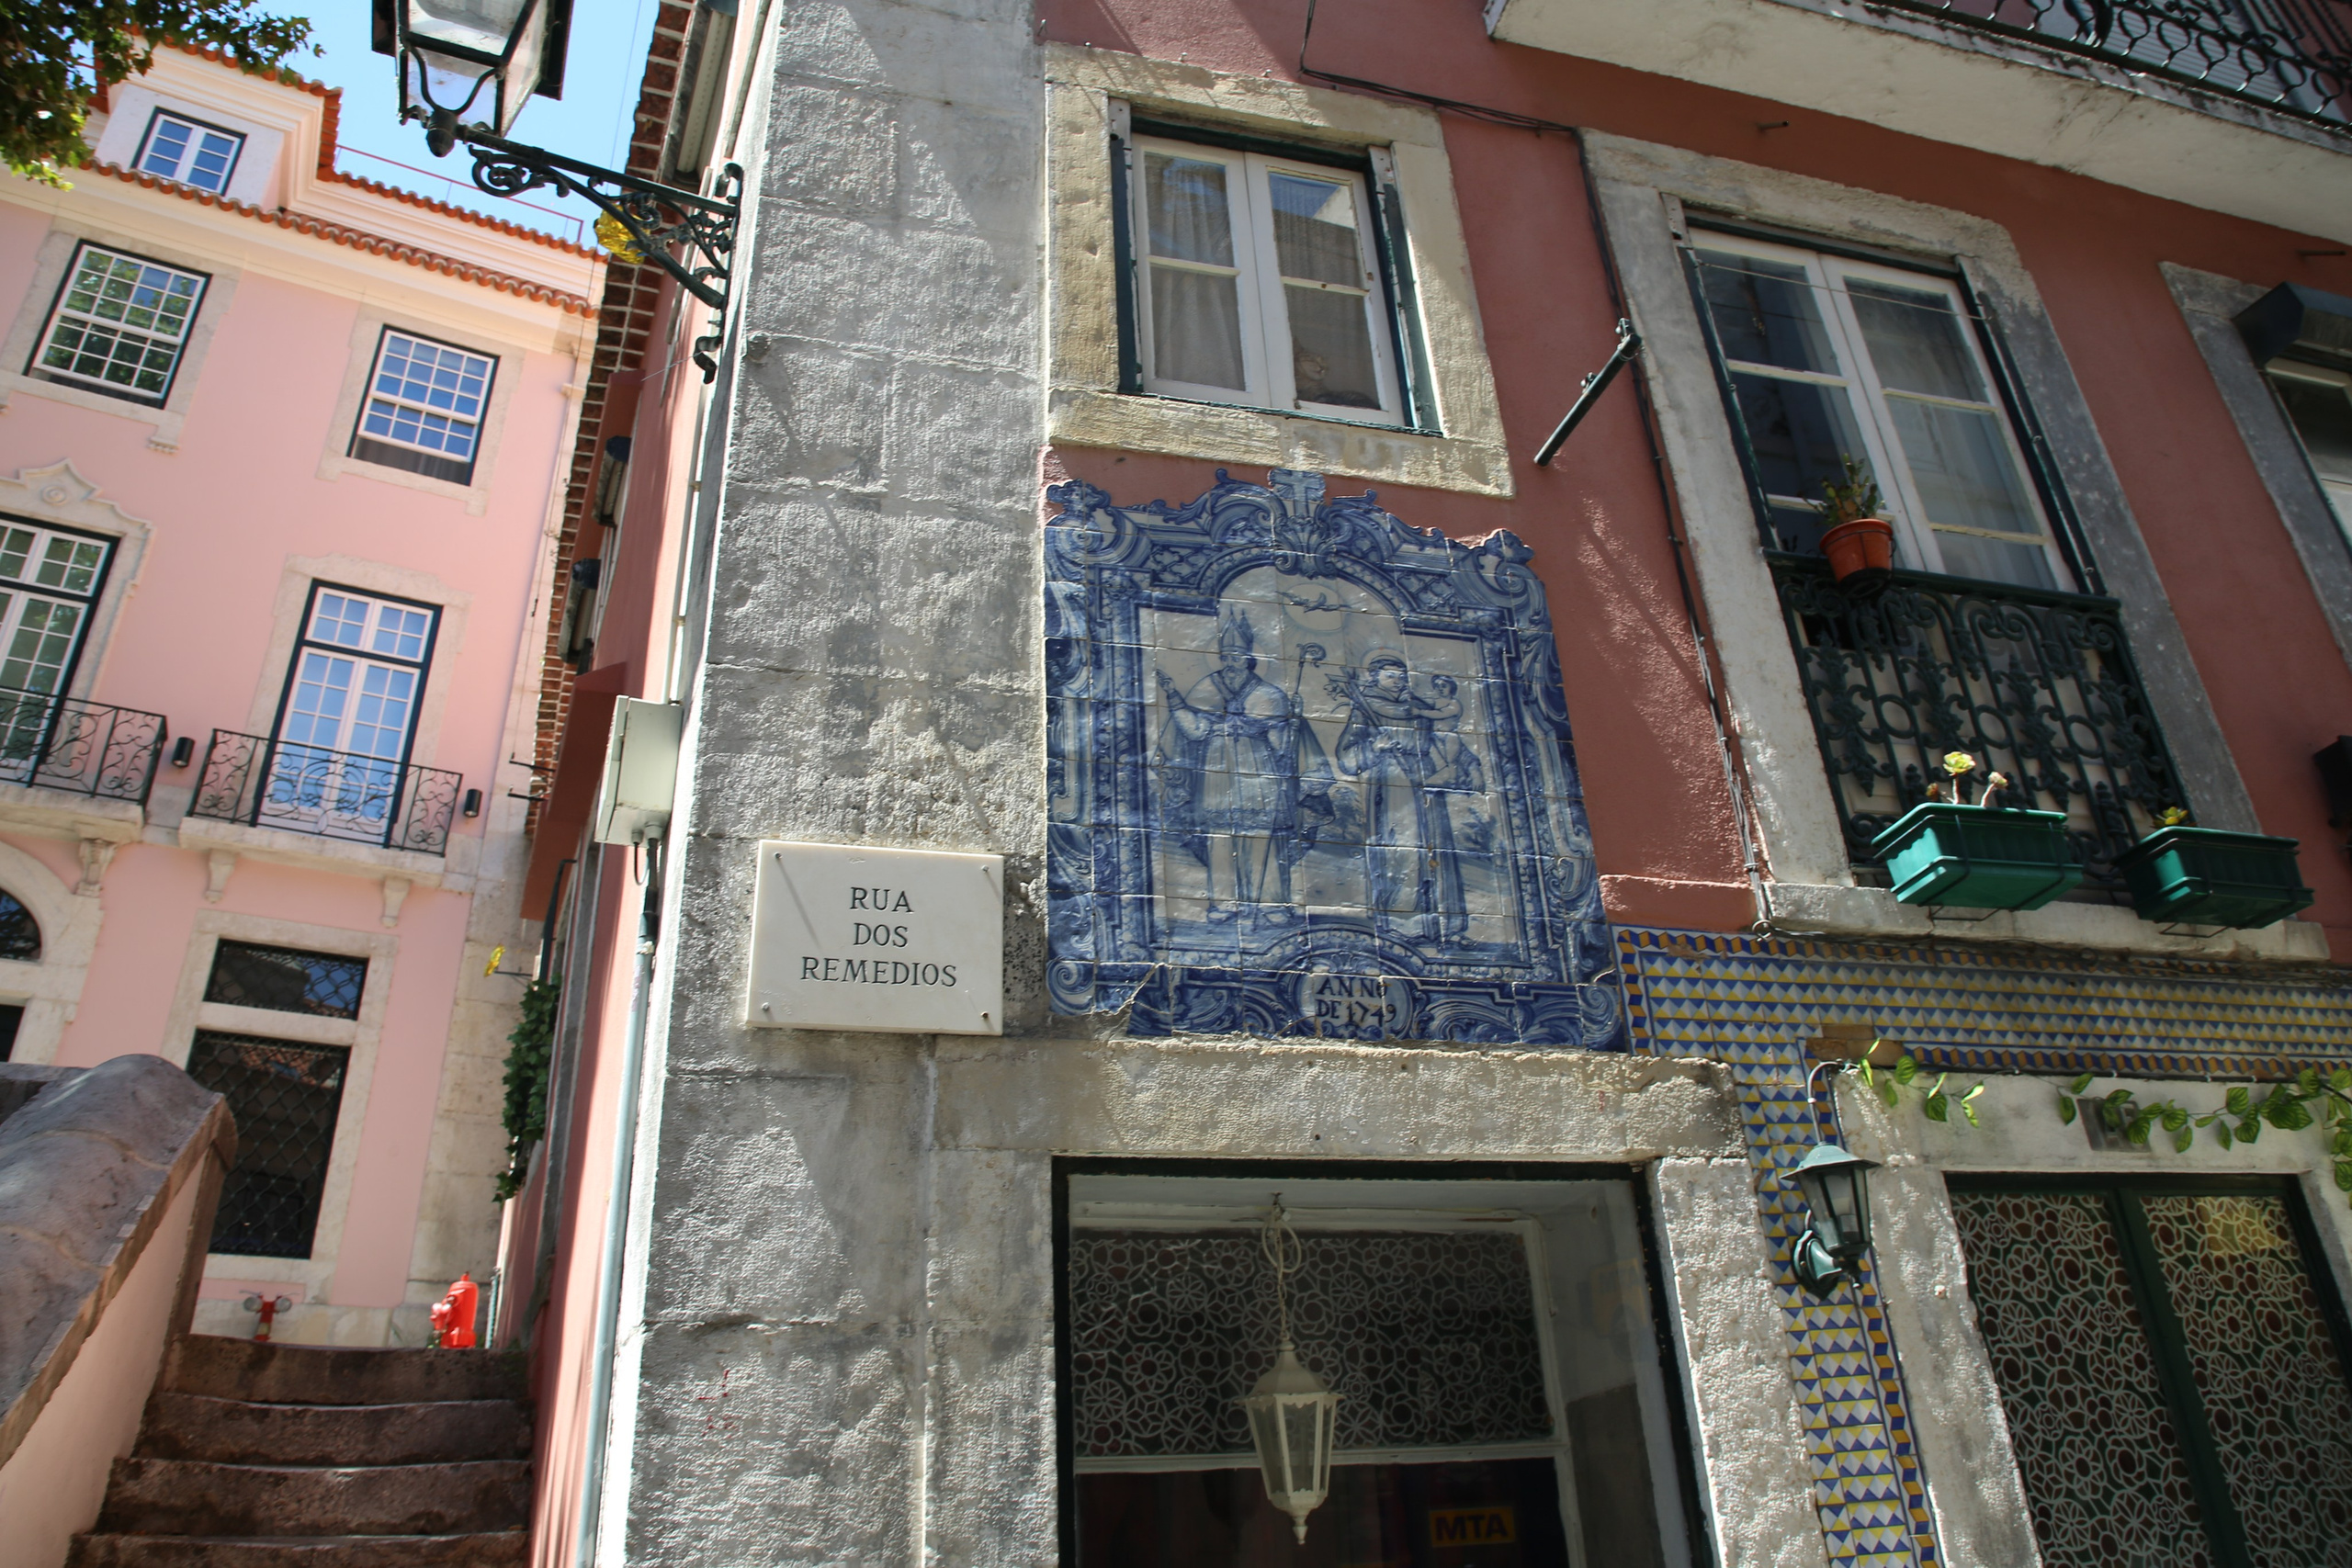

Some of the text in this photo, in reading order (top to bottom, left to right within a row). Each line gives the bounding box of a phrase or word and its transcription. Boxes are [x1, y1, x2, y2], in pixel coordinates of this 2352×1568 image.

[849, 886, 914, 914] RUA
[853, 922, 909, 948] DOS
[800, 956, 957, 987] REMEDIOS
[1316, 976, 1388, 998] ANNO
[1315, 998, 1341, 1019] DE
